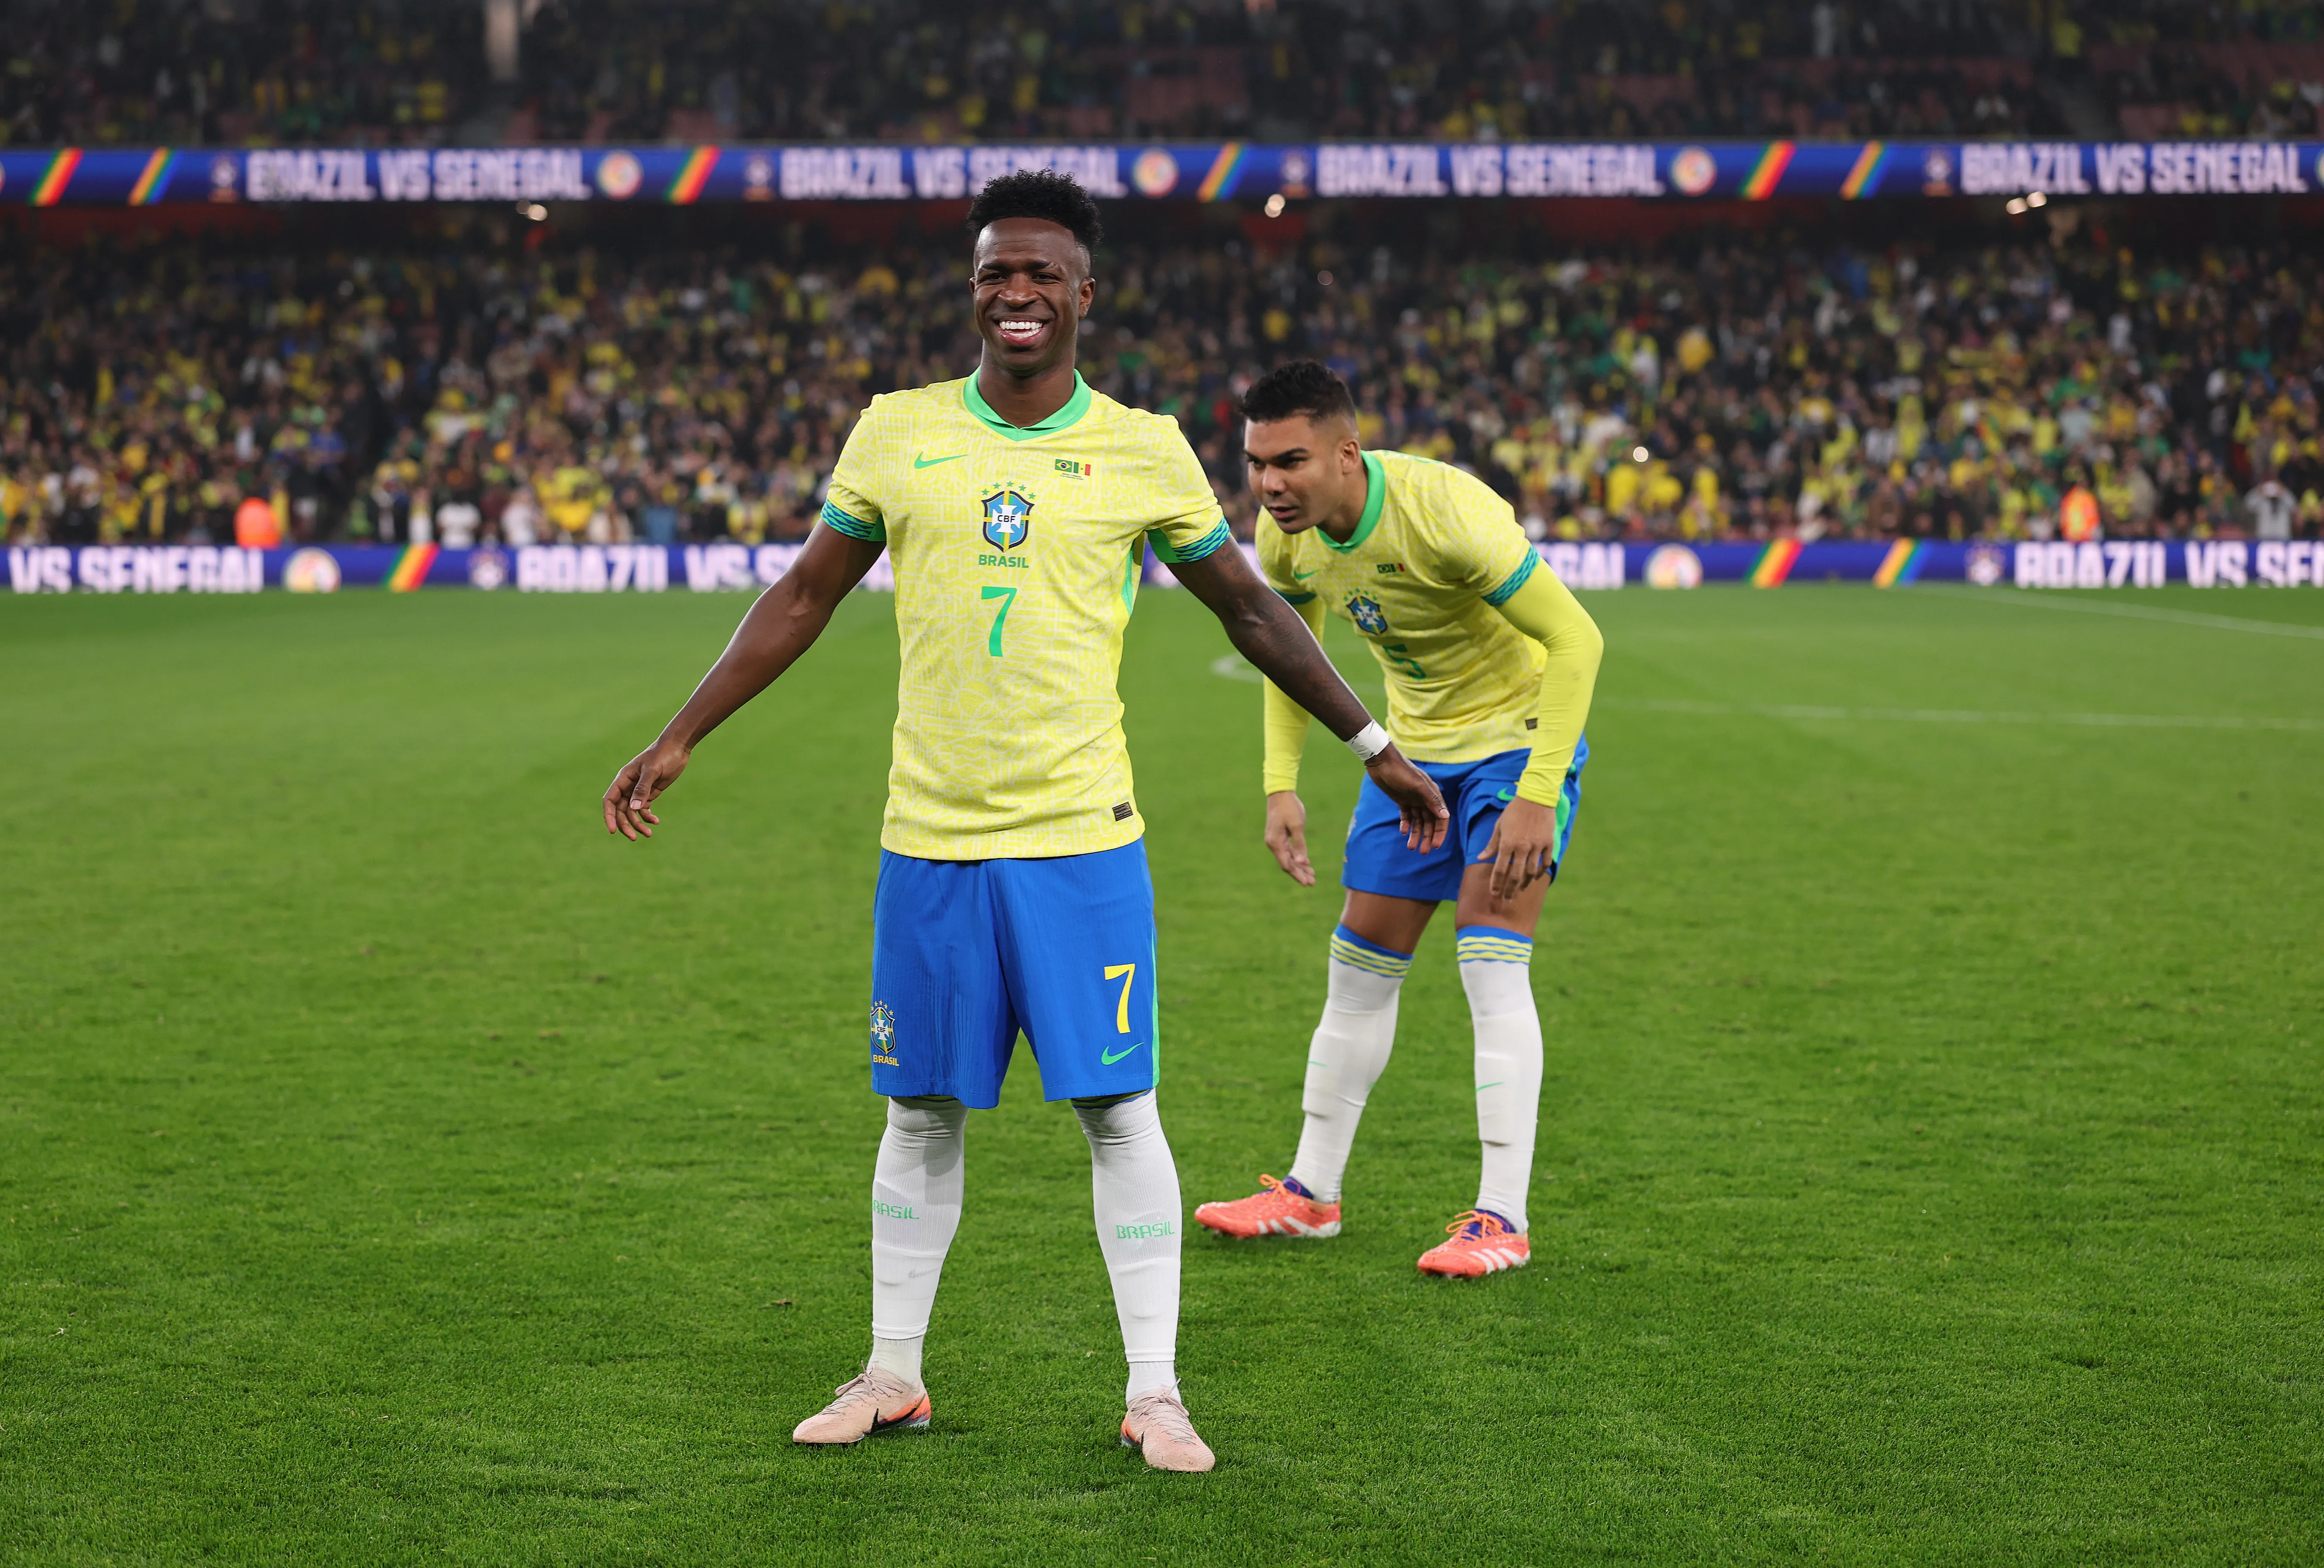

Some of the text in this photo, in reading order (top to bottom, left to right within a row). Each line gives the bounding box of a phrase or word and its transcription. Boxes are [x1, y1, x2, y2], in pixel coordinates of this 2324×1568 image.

[247, 149, 592, 201] BRAZIL VS SENEGAL
[781, 147, 911, 199] BRAZIL
[914, 147, 966, 199] VS
[1317, 145, 1666, 197] BRAZIL VS SENEGAL
[1961, 142, 2308, 195] BRAZIL VS SENEGAL
[998, 515, 1016, 523] CBF
[8, 546, 72, 593] VS
[979, 554, 1029, 568] BRASIL
[2185, 540, 2248, 589] VS
[981, 586, 1017, 657] 7
[1104, 963, 1136, 1034] 7
[873, 1054, 900, 1066] BRASIL
[873, 1198, 920, 1220] RASIL
[1115, 1221, 1175, 1239] BRASIL
